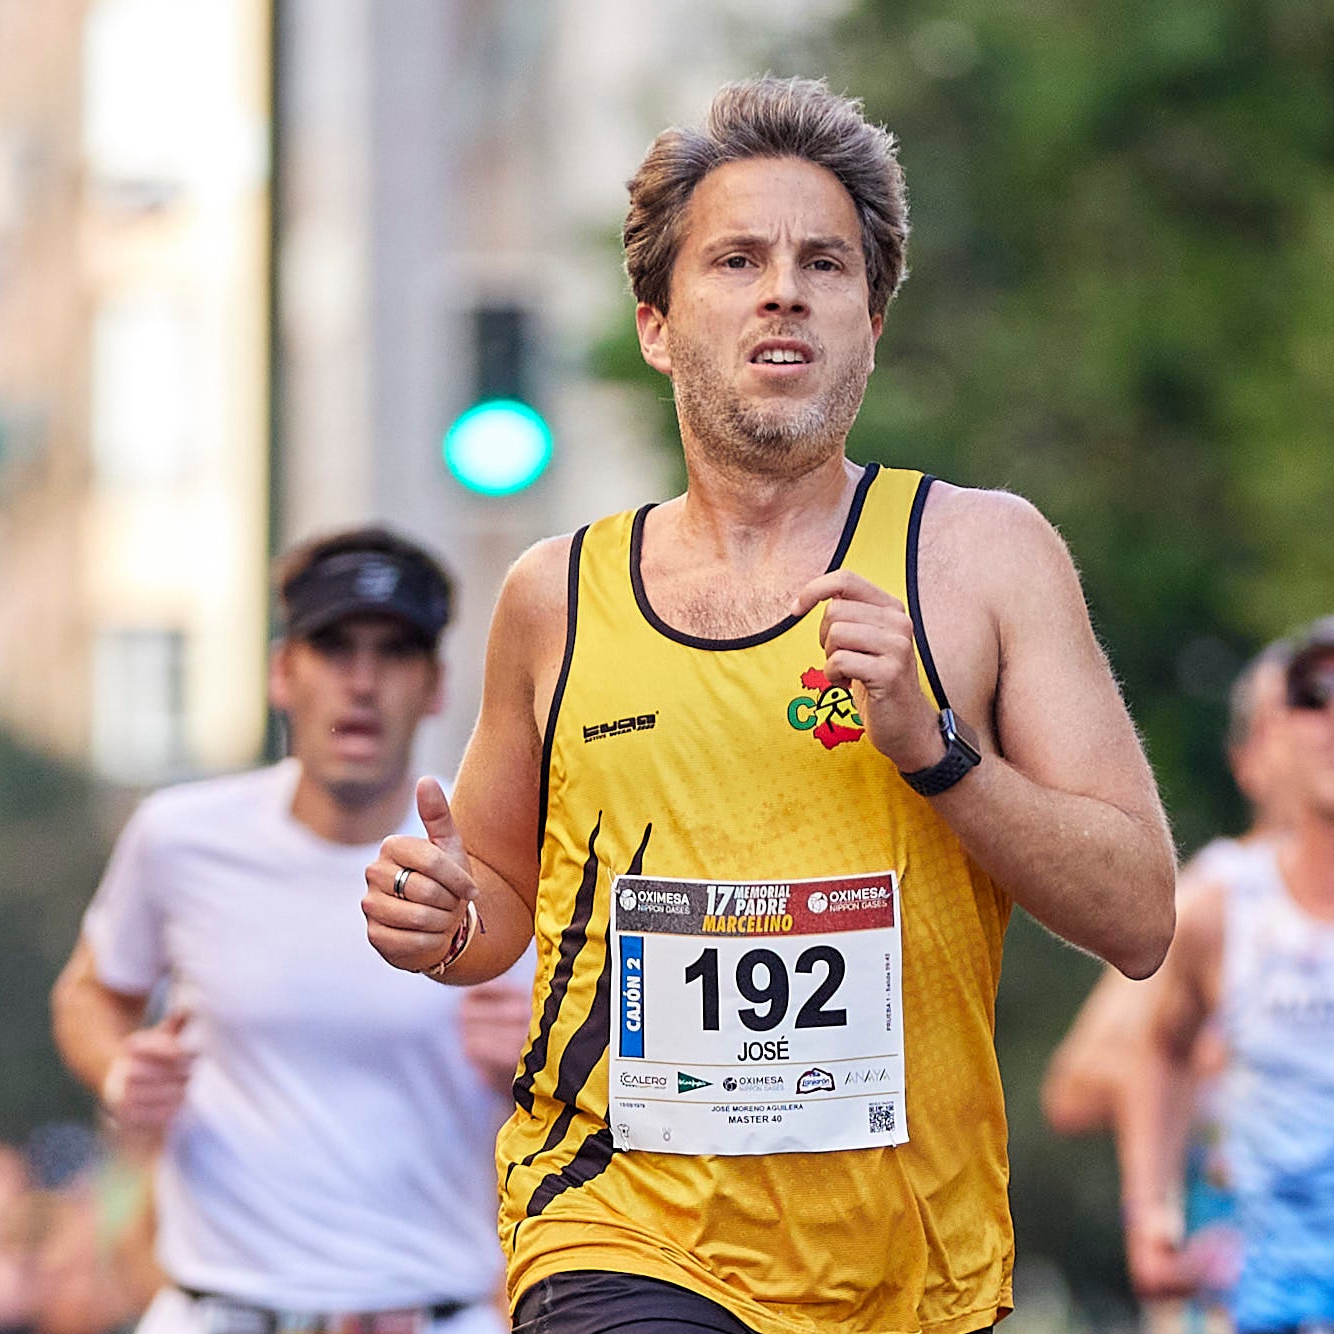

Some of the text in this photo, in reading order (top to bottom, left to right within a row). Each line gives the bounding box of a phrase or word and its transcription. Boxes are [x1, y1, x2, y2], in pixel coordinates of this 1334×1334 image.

[638, 890, 690, 905] OXIMESA
[707, 885, 791, 916] 17 MEMORIAL
[829, 886, 888, 903] OXIMESA
[735, 897, 787, 916] PADRE
[830, 902, 859, 913] NIPPON
[702, 914, 793, 933] MARCELINO
[623, 957, 642, 1032] CAJÓN 2
[685, 945, 847, 1032] 192
[737, 1035, 790, 1062] JOSÉ
[624, 1075, 667, 1086] CALERO
[739, 1076, 784, 1085] OXIMESA
[728, 1114, 782, 1124] MASTER 40
